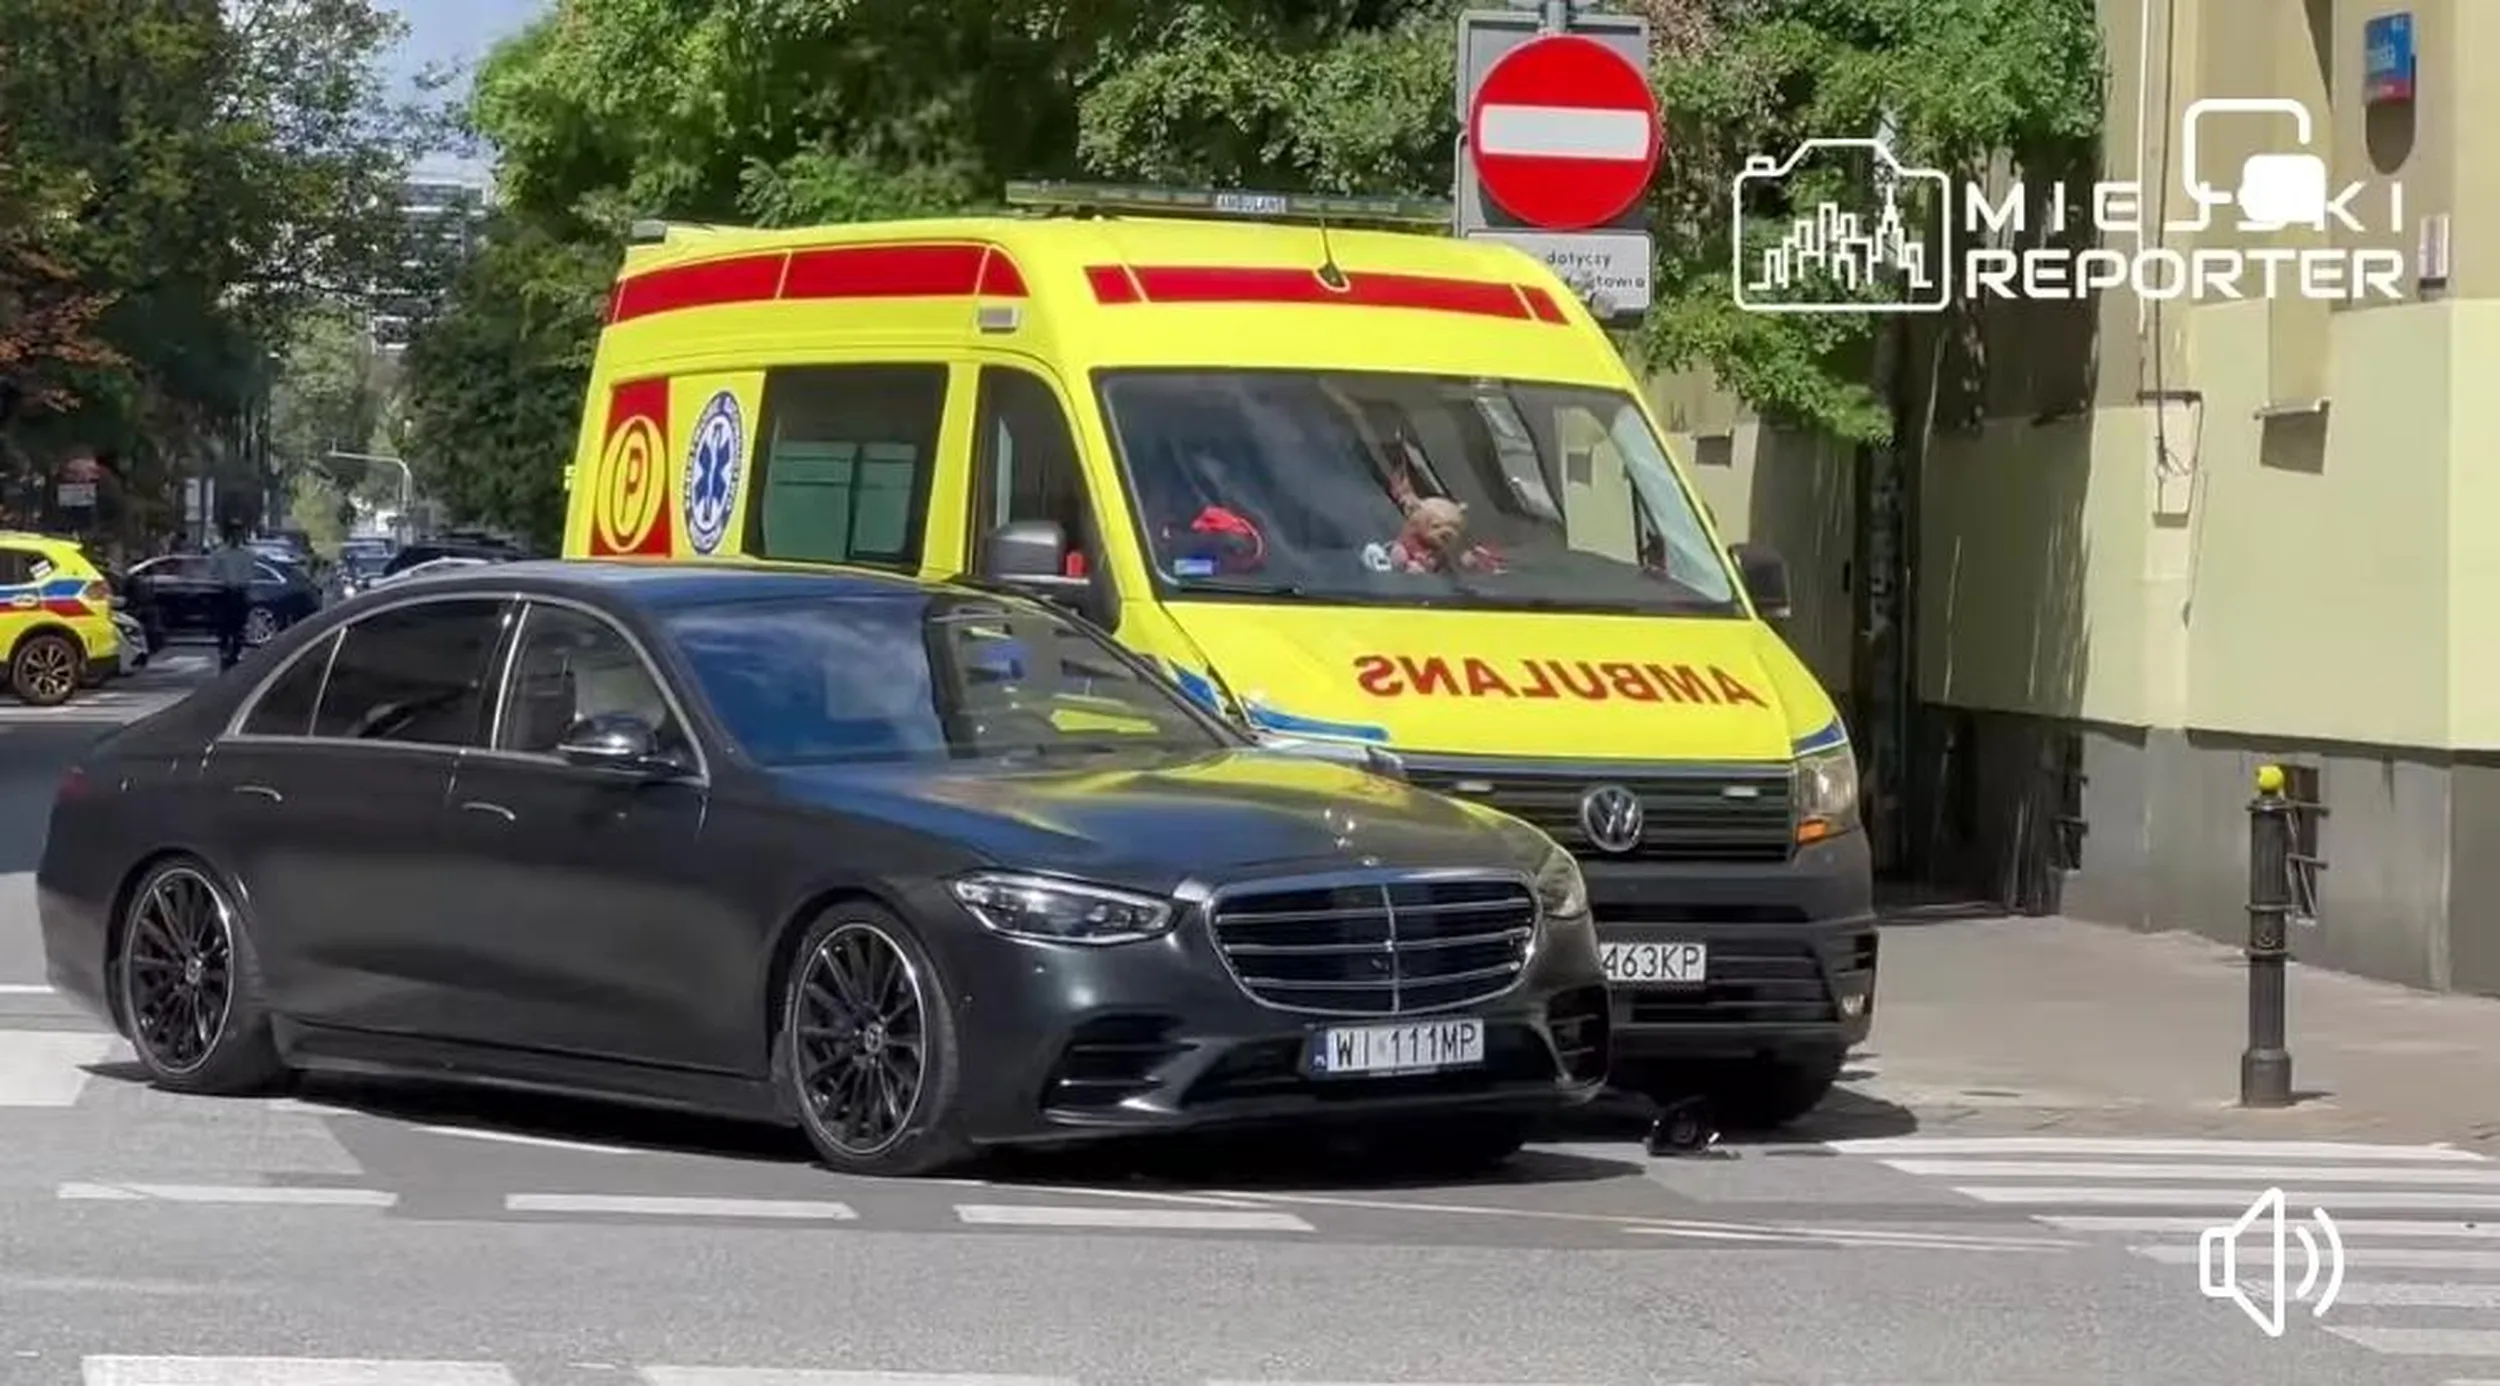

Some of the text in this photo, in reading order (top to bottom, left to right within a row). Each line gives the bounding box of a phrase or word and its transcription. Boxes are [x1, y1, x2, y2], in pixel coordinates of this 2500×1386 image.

[1547, 251, 1611, 267] dotyczy
[1603, 946, 1700, 978] 463KP
[1391, 1023, 1476, 1062] 111MP
